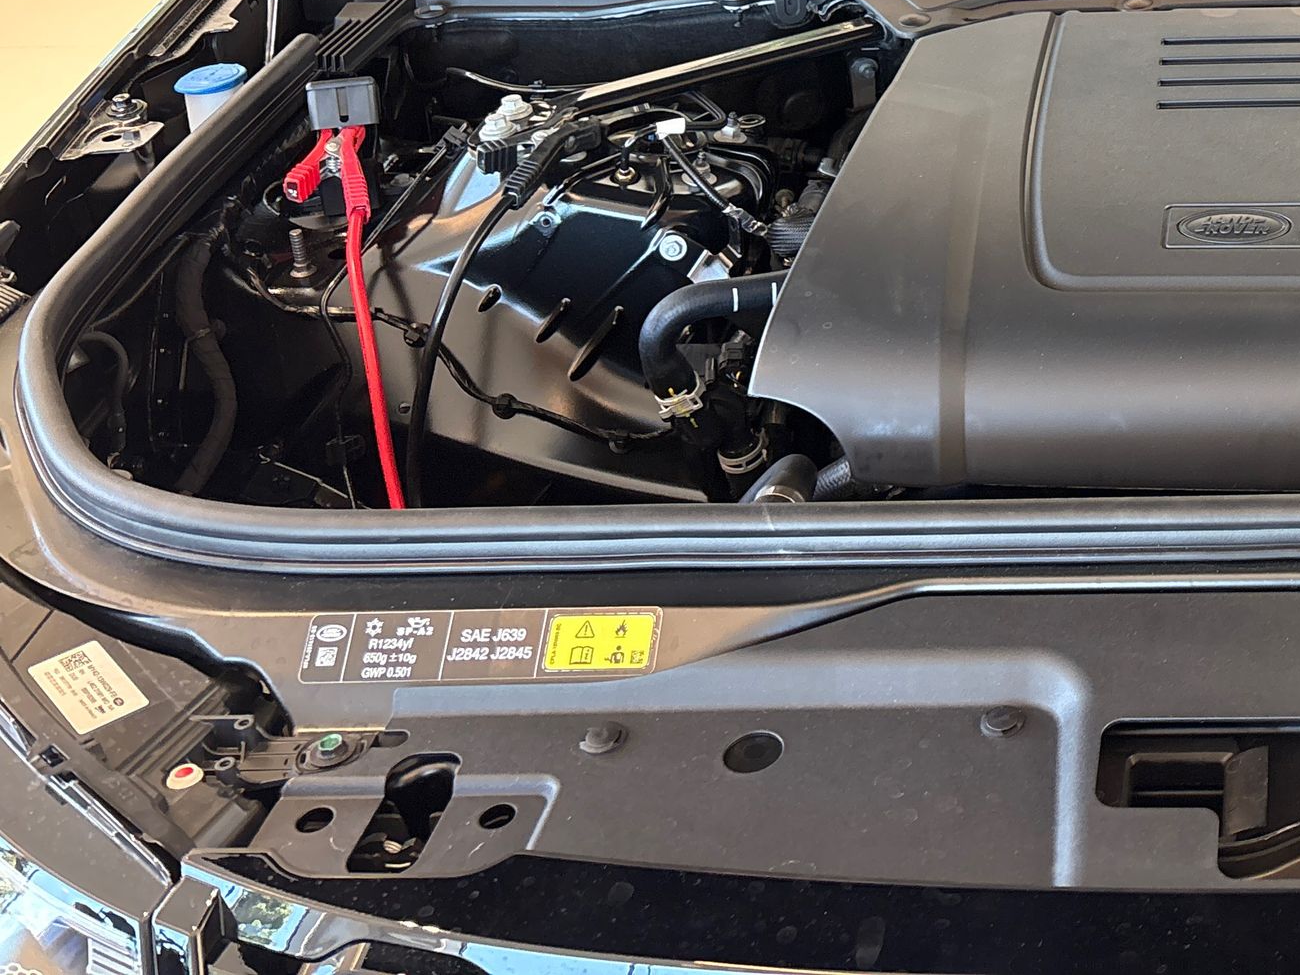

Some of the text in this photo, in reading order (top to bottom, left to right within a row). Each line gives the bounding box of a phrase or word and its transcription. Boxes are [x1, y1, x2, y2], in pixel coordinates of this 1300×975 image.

[460, 628, 527, 643] SAE J639
[368, 637, 415, 652] R1234yf
[362, 652, 418, 665] 650g ±10g
[446, 646, 533, 661] J2842 J2845
[361, 666, 412, 679] GWP 0.501
